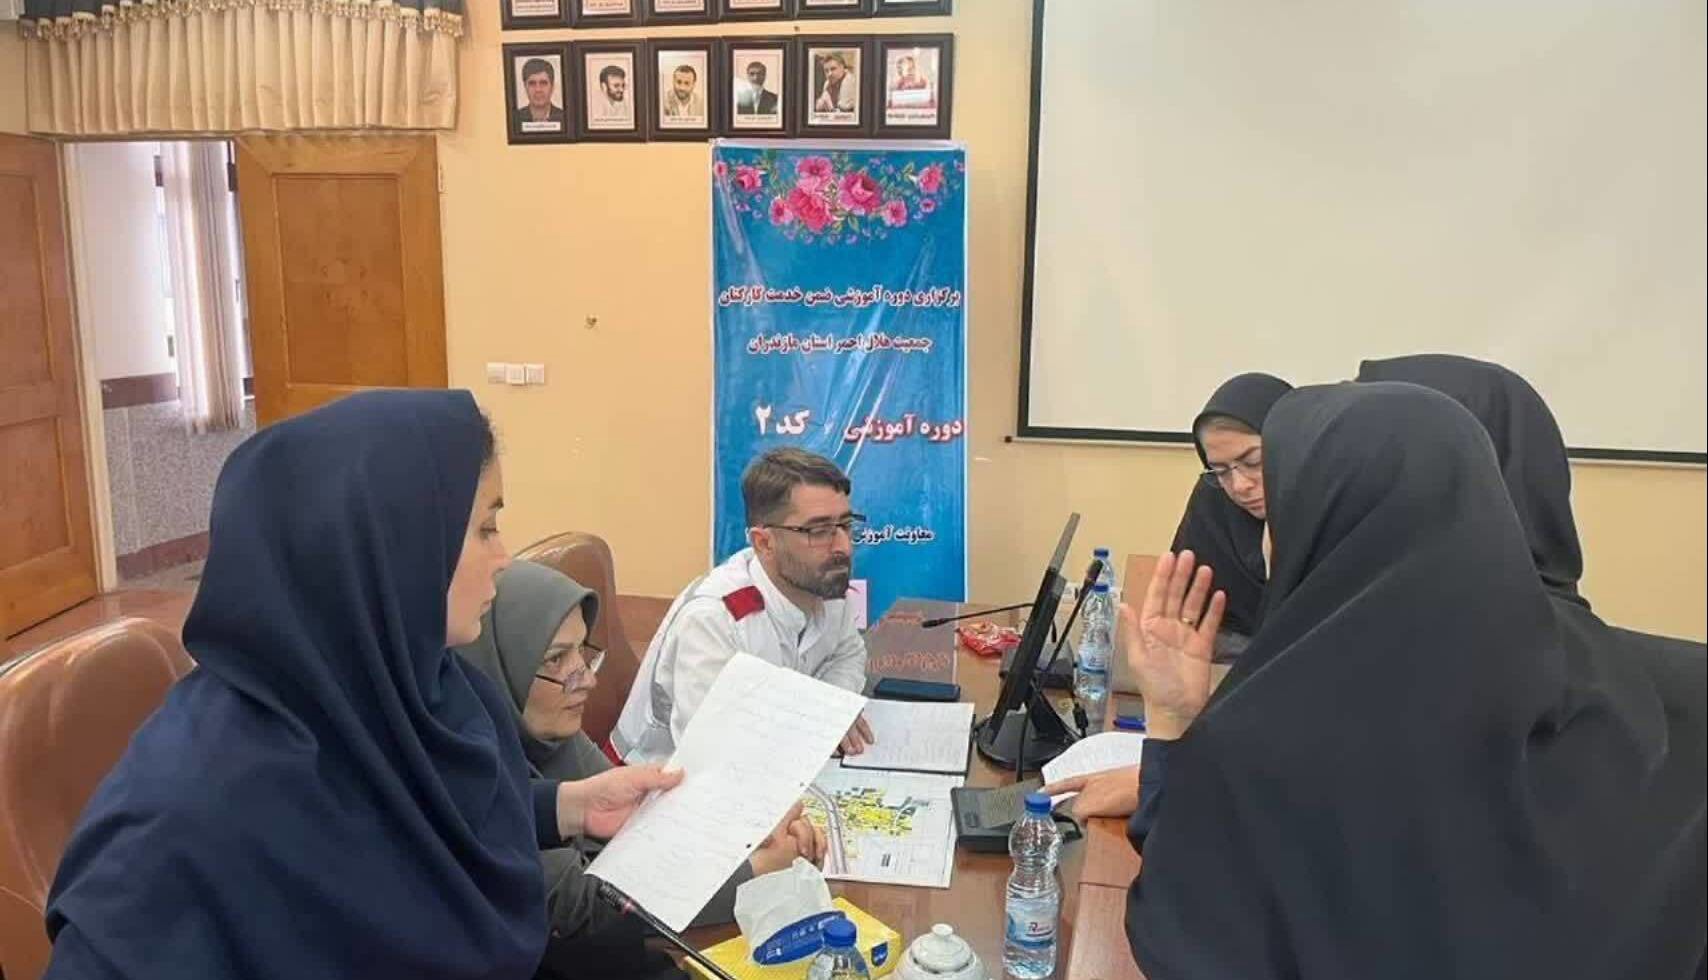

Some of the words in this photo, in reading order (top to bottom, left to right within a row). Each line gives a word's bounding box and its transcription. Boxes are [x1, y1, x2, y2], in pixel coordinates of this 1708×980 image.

[765, 287, 803, 303] خدمت
[804, 287, 833, 307] ضمن
[834, 284, 883, 307] آموزشی
[884, 289, 912, 307] دوره
[913, 286, 961, 307] برگزاری
[747, 332, 800, 354] مازندران
[801, 332, 833, 353] استان
[834, 333, 863, 354] احمر
[864, 331, 892, 353] هلال
[893, 336, 933, 353] جمعیت
[755, 404, 772, 435] ۲
[775, 409, 810, 435] کد
[920, 418, 964, 441] دوره
[894, 526, 935, 545] معاونت
